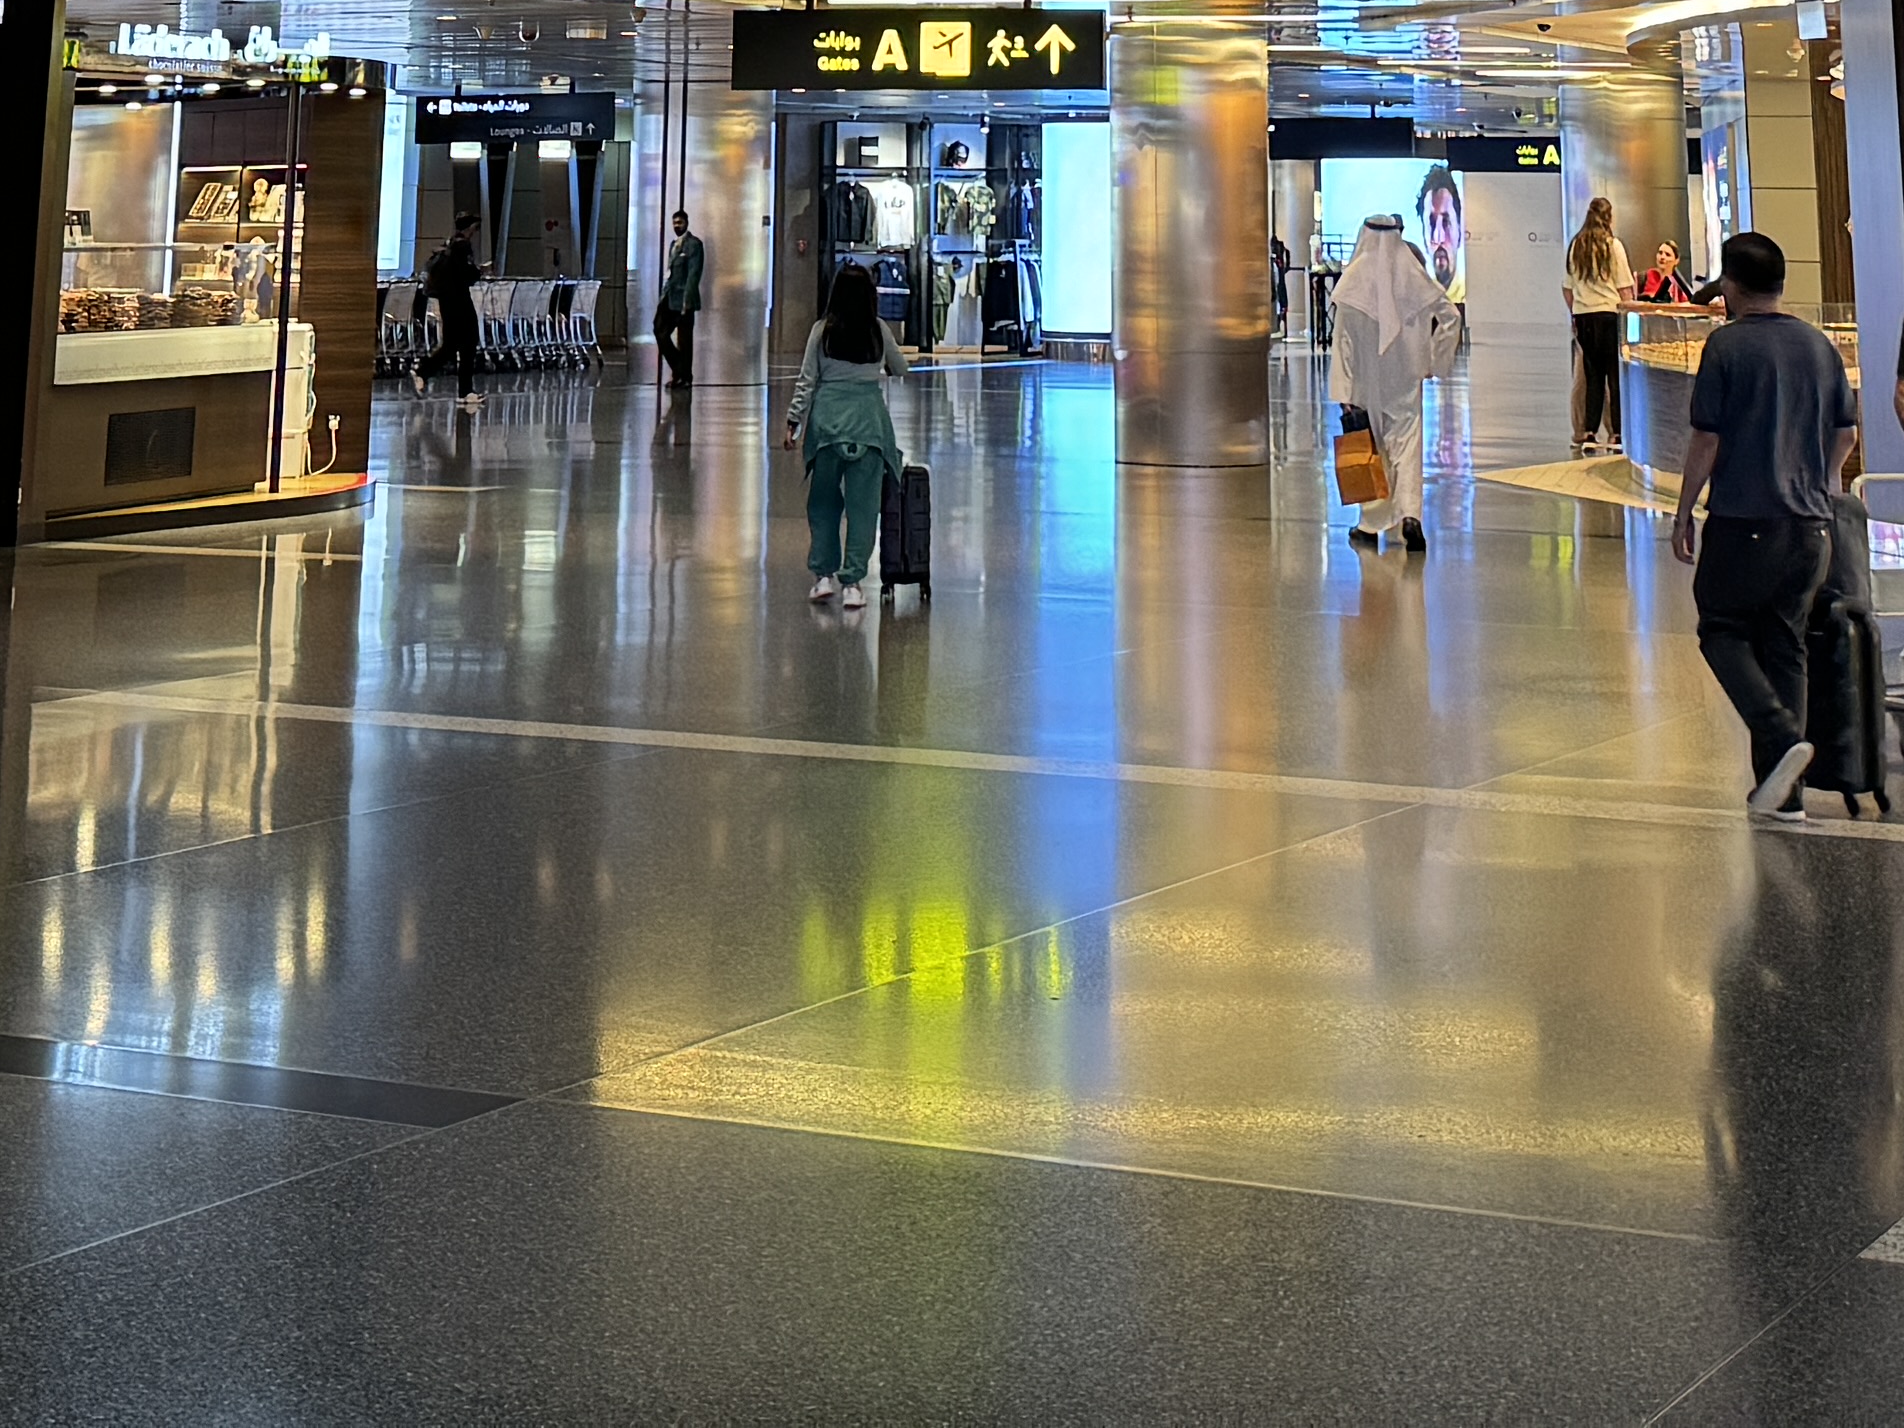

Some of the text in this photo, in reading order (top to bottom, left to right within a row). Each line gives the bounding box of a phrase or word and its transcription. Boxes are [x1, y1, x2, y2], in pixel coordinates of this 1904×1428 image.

[816, 28, 908, 72] Gates A
[490, 127, 525, 138] Lounges
